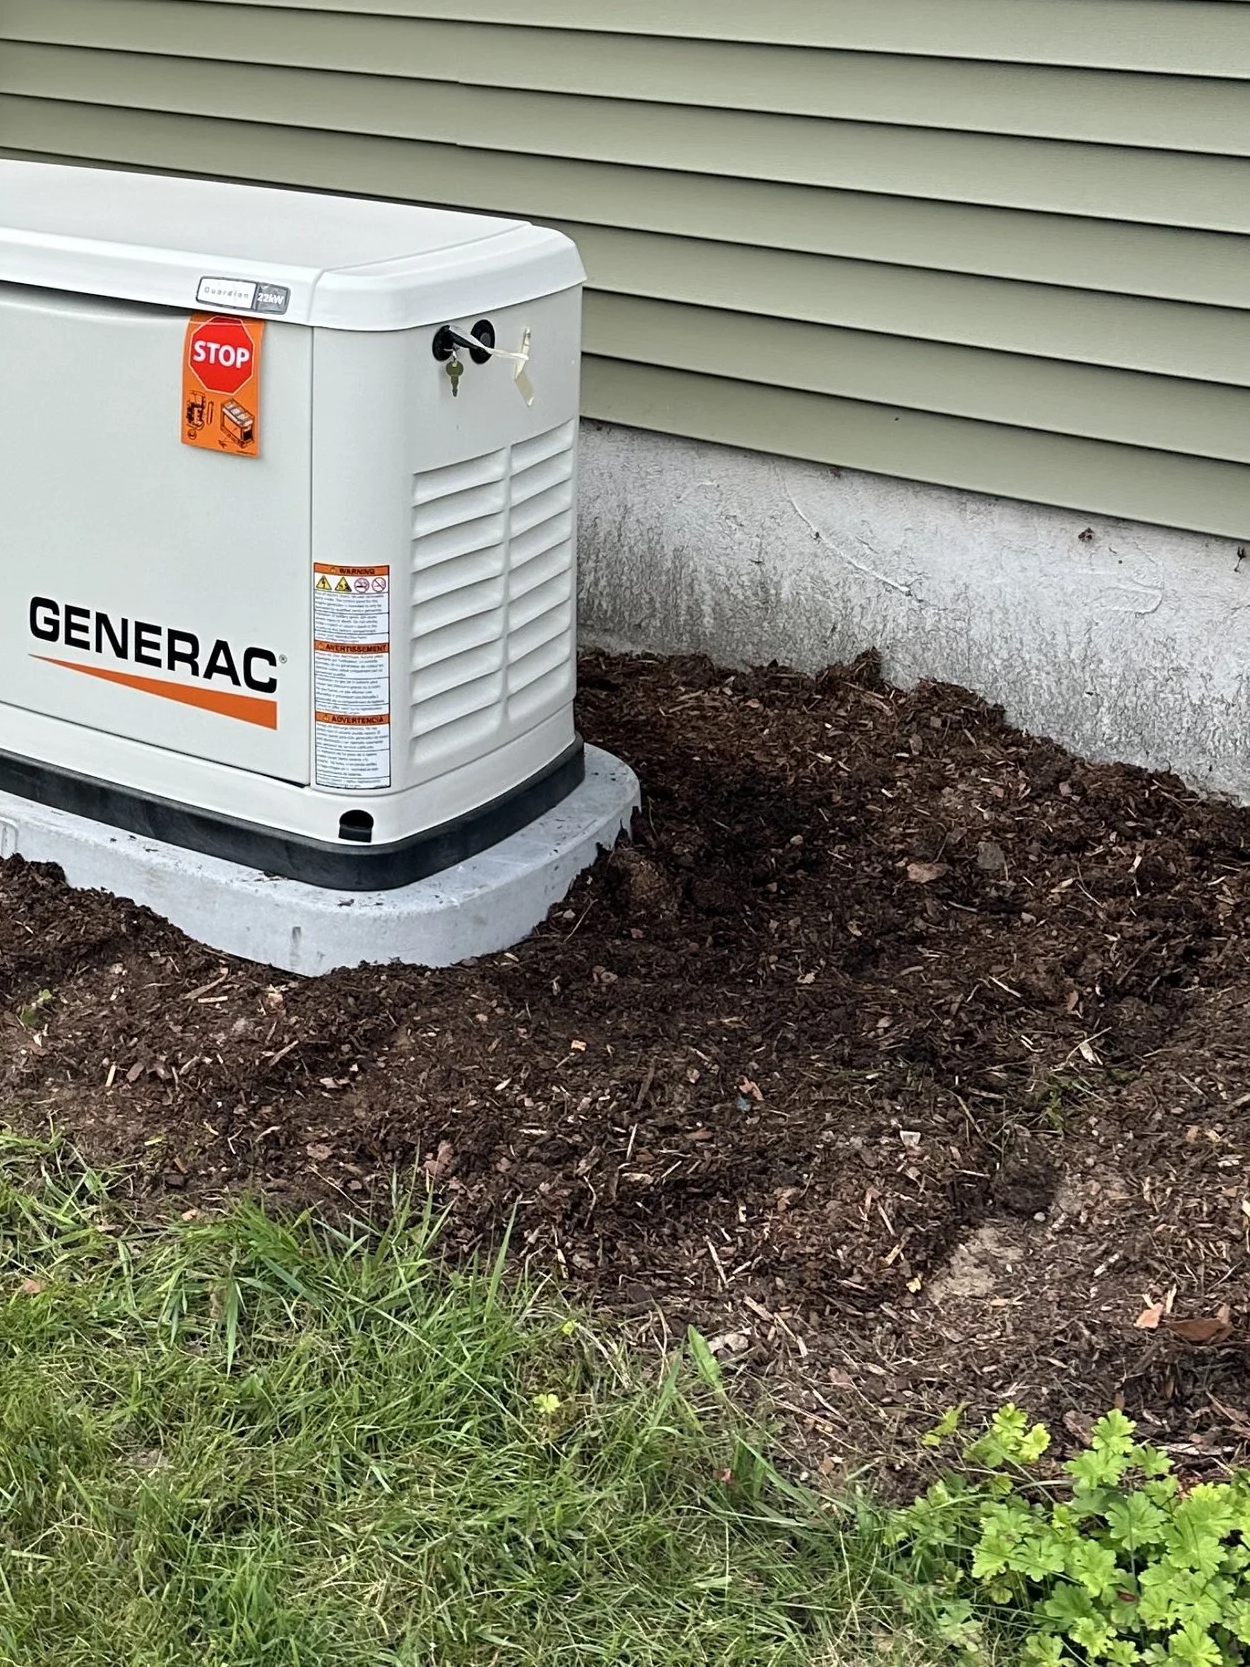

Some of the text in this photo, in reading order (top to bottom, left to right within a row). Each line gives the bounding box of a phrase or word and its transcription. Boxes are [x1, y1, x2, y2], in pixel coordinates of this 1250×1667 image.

[257, 292, 285, 305] 22kW
[193, 340, 250, 369] STOP
[29, 596, 278, 694] GENERAC
[325, 643, 387, 653] AVERTISSEMENT
[331, 716, 384, 724] ADVERTENCIA
